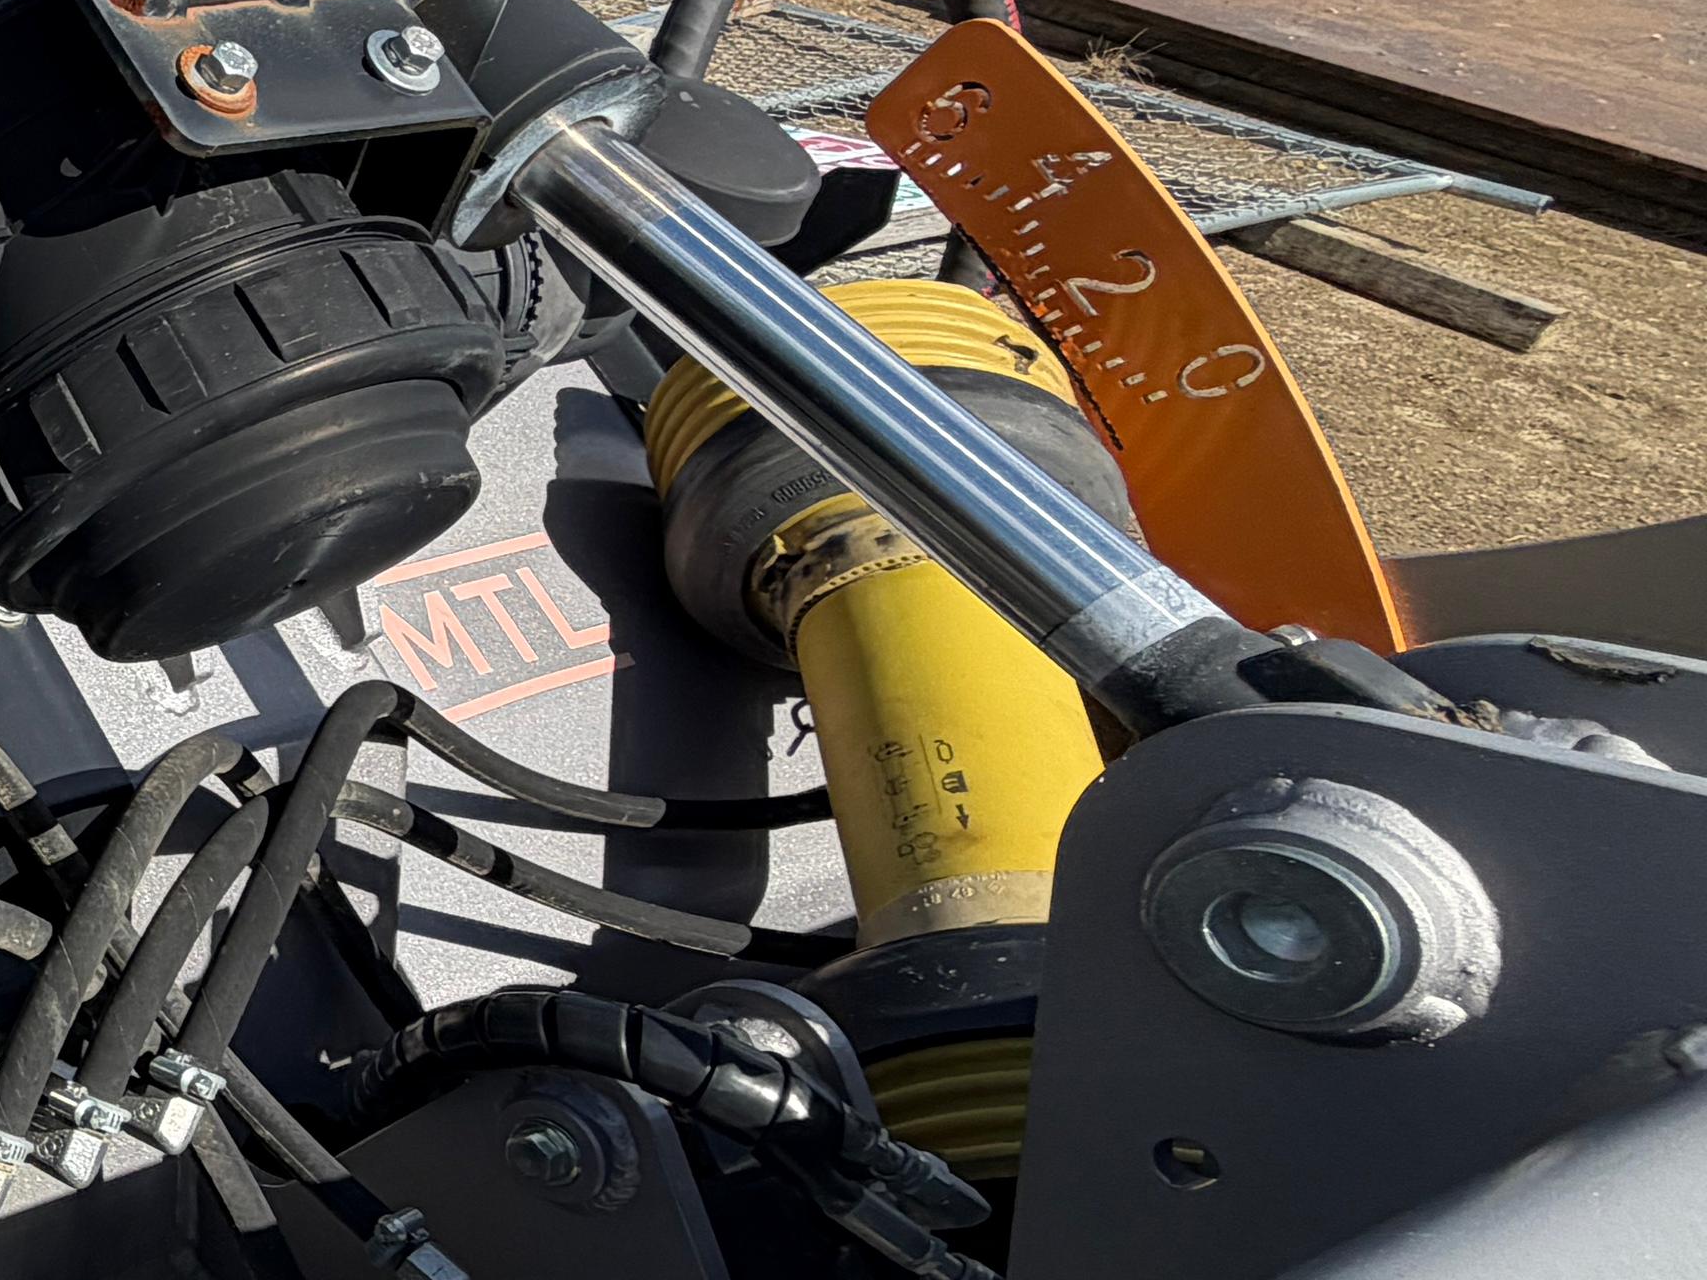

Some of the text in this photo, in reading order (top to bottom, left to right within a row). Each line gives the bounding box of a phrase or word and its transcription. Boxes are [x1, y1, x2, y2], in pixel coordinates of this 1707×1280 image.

[918, 80, 1266, 399] 6 4 2 0
[379, 566, 610, 691] MTL
